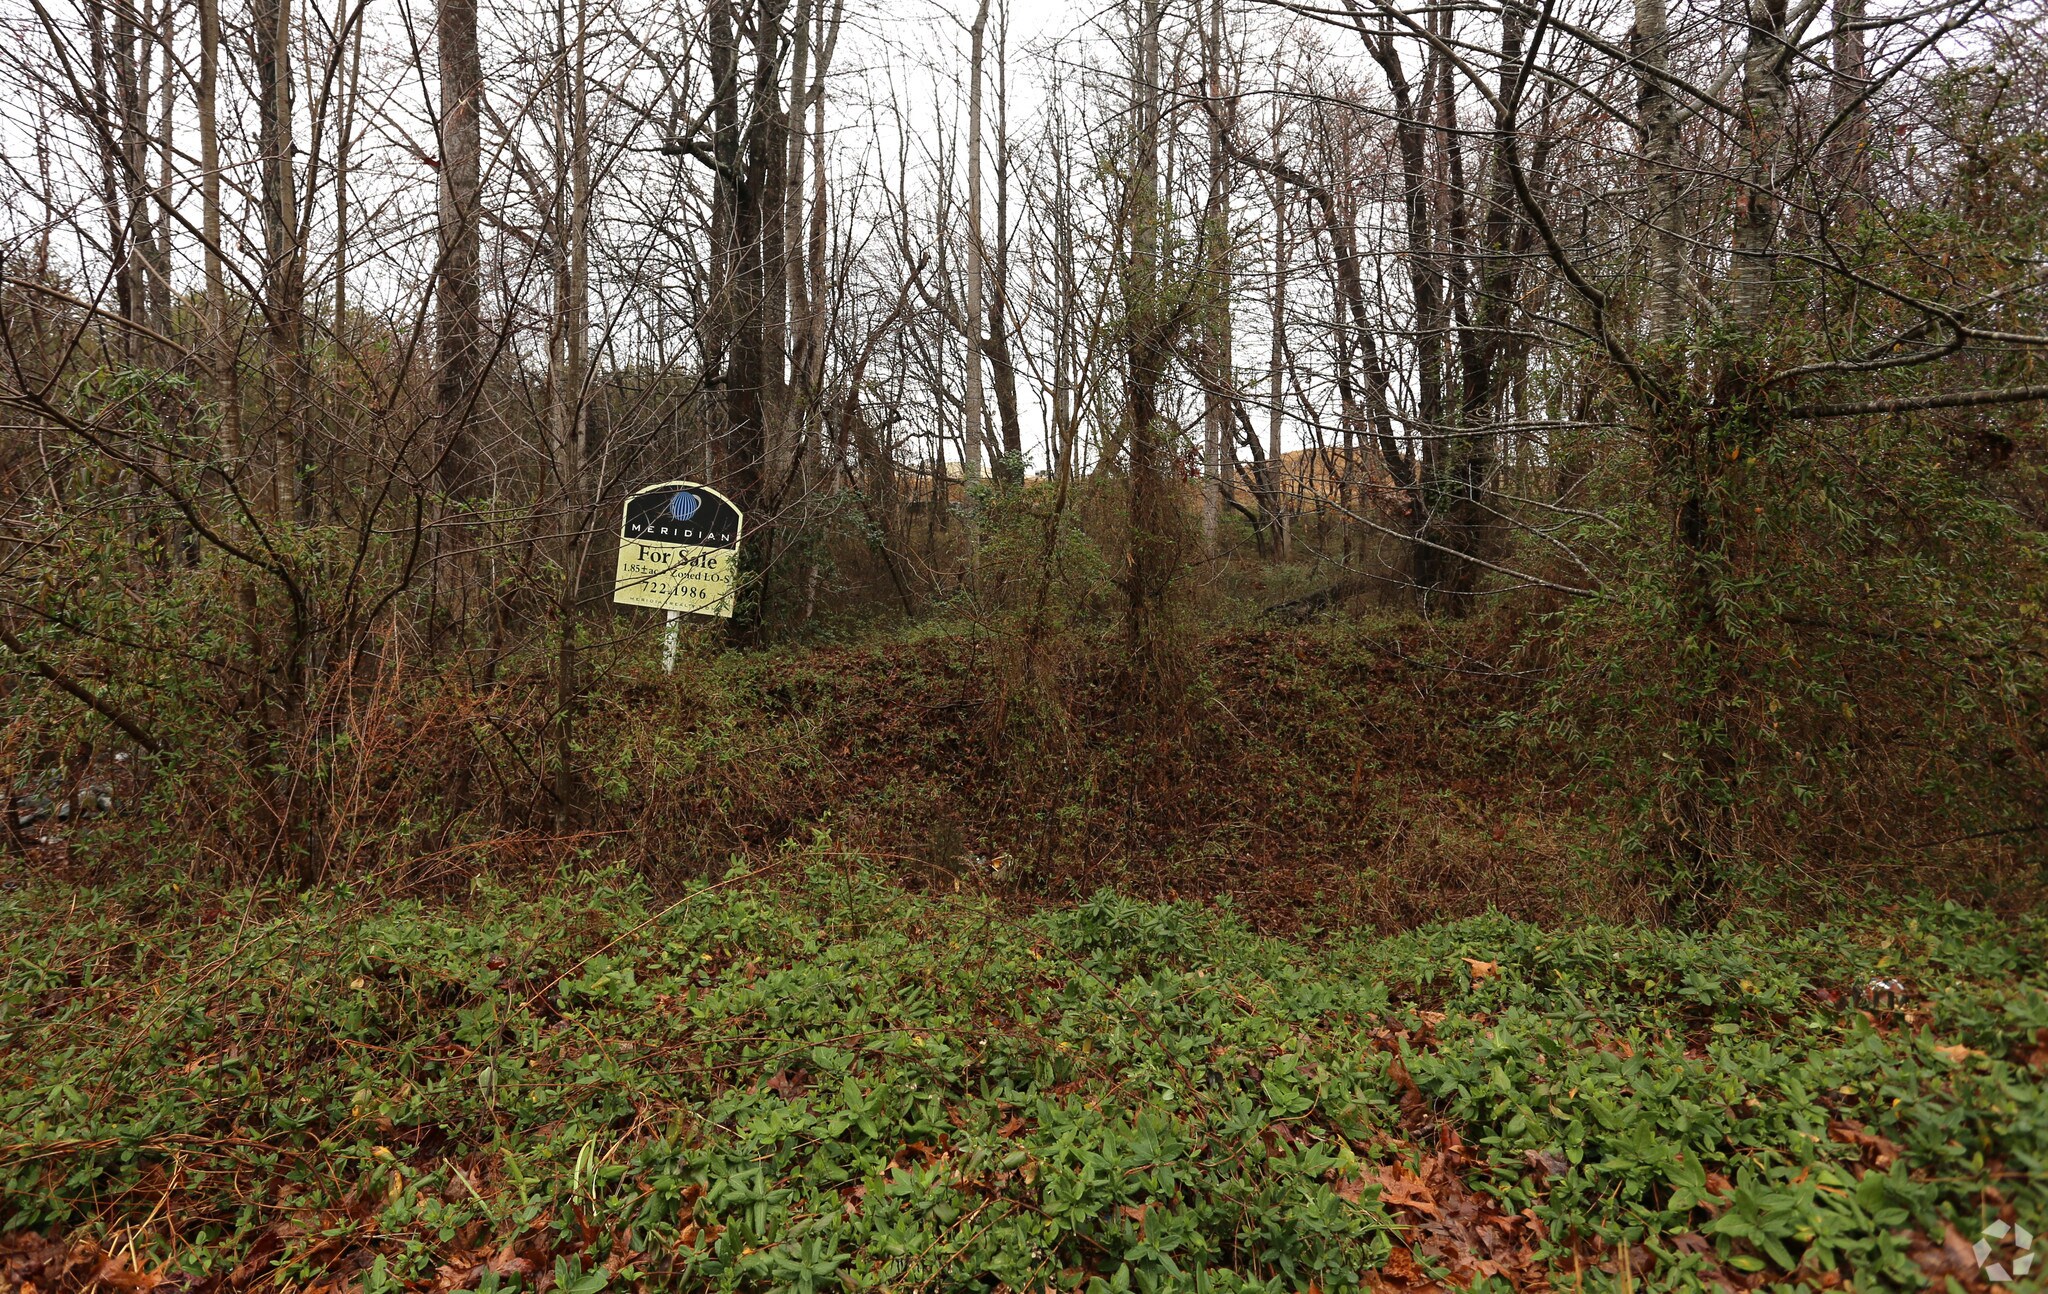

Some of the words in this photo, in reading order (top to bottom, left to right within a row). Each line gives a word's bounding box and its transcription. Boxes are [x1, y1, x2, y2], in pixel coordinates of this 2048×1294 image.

[631, 523, 730, 542] MERIDIAN
[637, 545, 671, 564] For
[678, 549, 717, 570] Sale
[670, 569, 701, 581] Zoned
